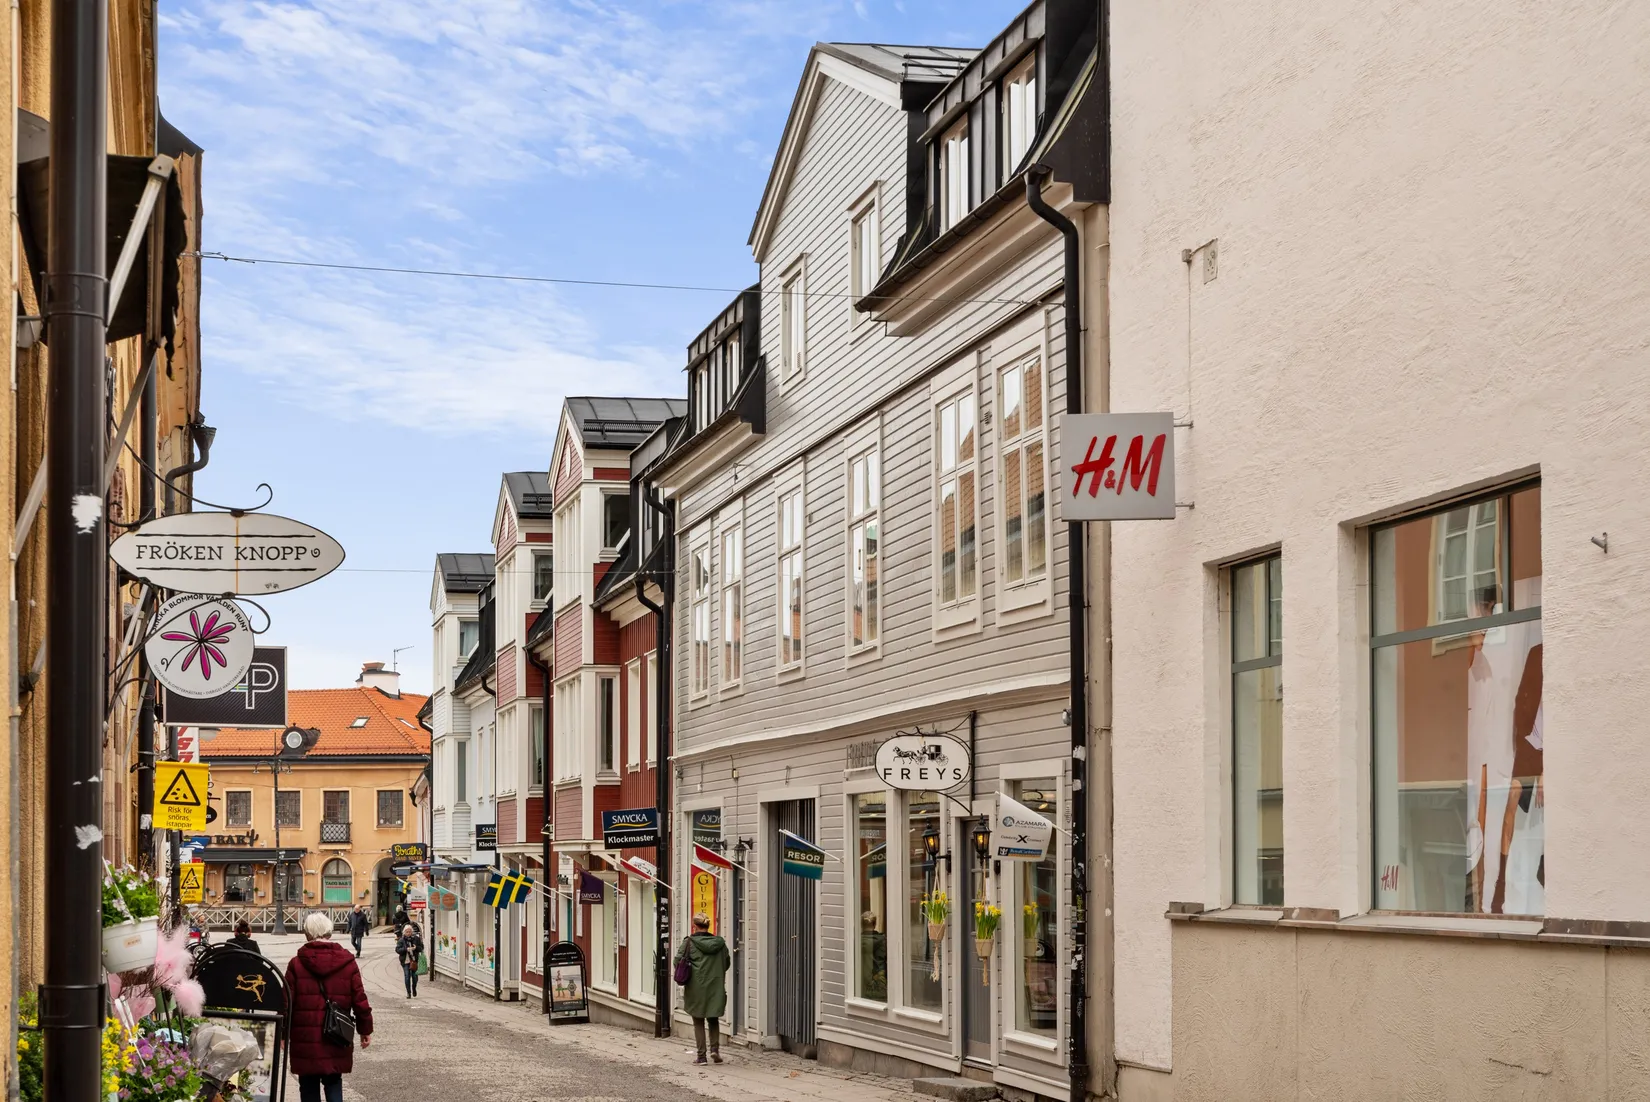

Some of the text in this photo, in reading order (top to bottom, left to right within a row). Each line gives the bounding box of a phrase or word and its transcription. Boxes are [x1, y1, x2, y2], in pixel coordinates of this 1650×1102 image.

[1071, 434, 1167, 498] H&M
[135, 541, 308, 561] FRÖKEN KNOPP
[169, 594, 204, 609] BLOMMOR
[234, 613, 249, 632] RUNT
[883, 768, 962, 780] FREYS
[167, 806, 182, 814] Risk
[611, 813, 648, 824] SMYCKA
[607, 834, 655, 844] Klockmaster
[787, 850, 821, 863] RESOR
[1380, 865, 1399, 891] H&M
